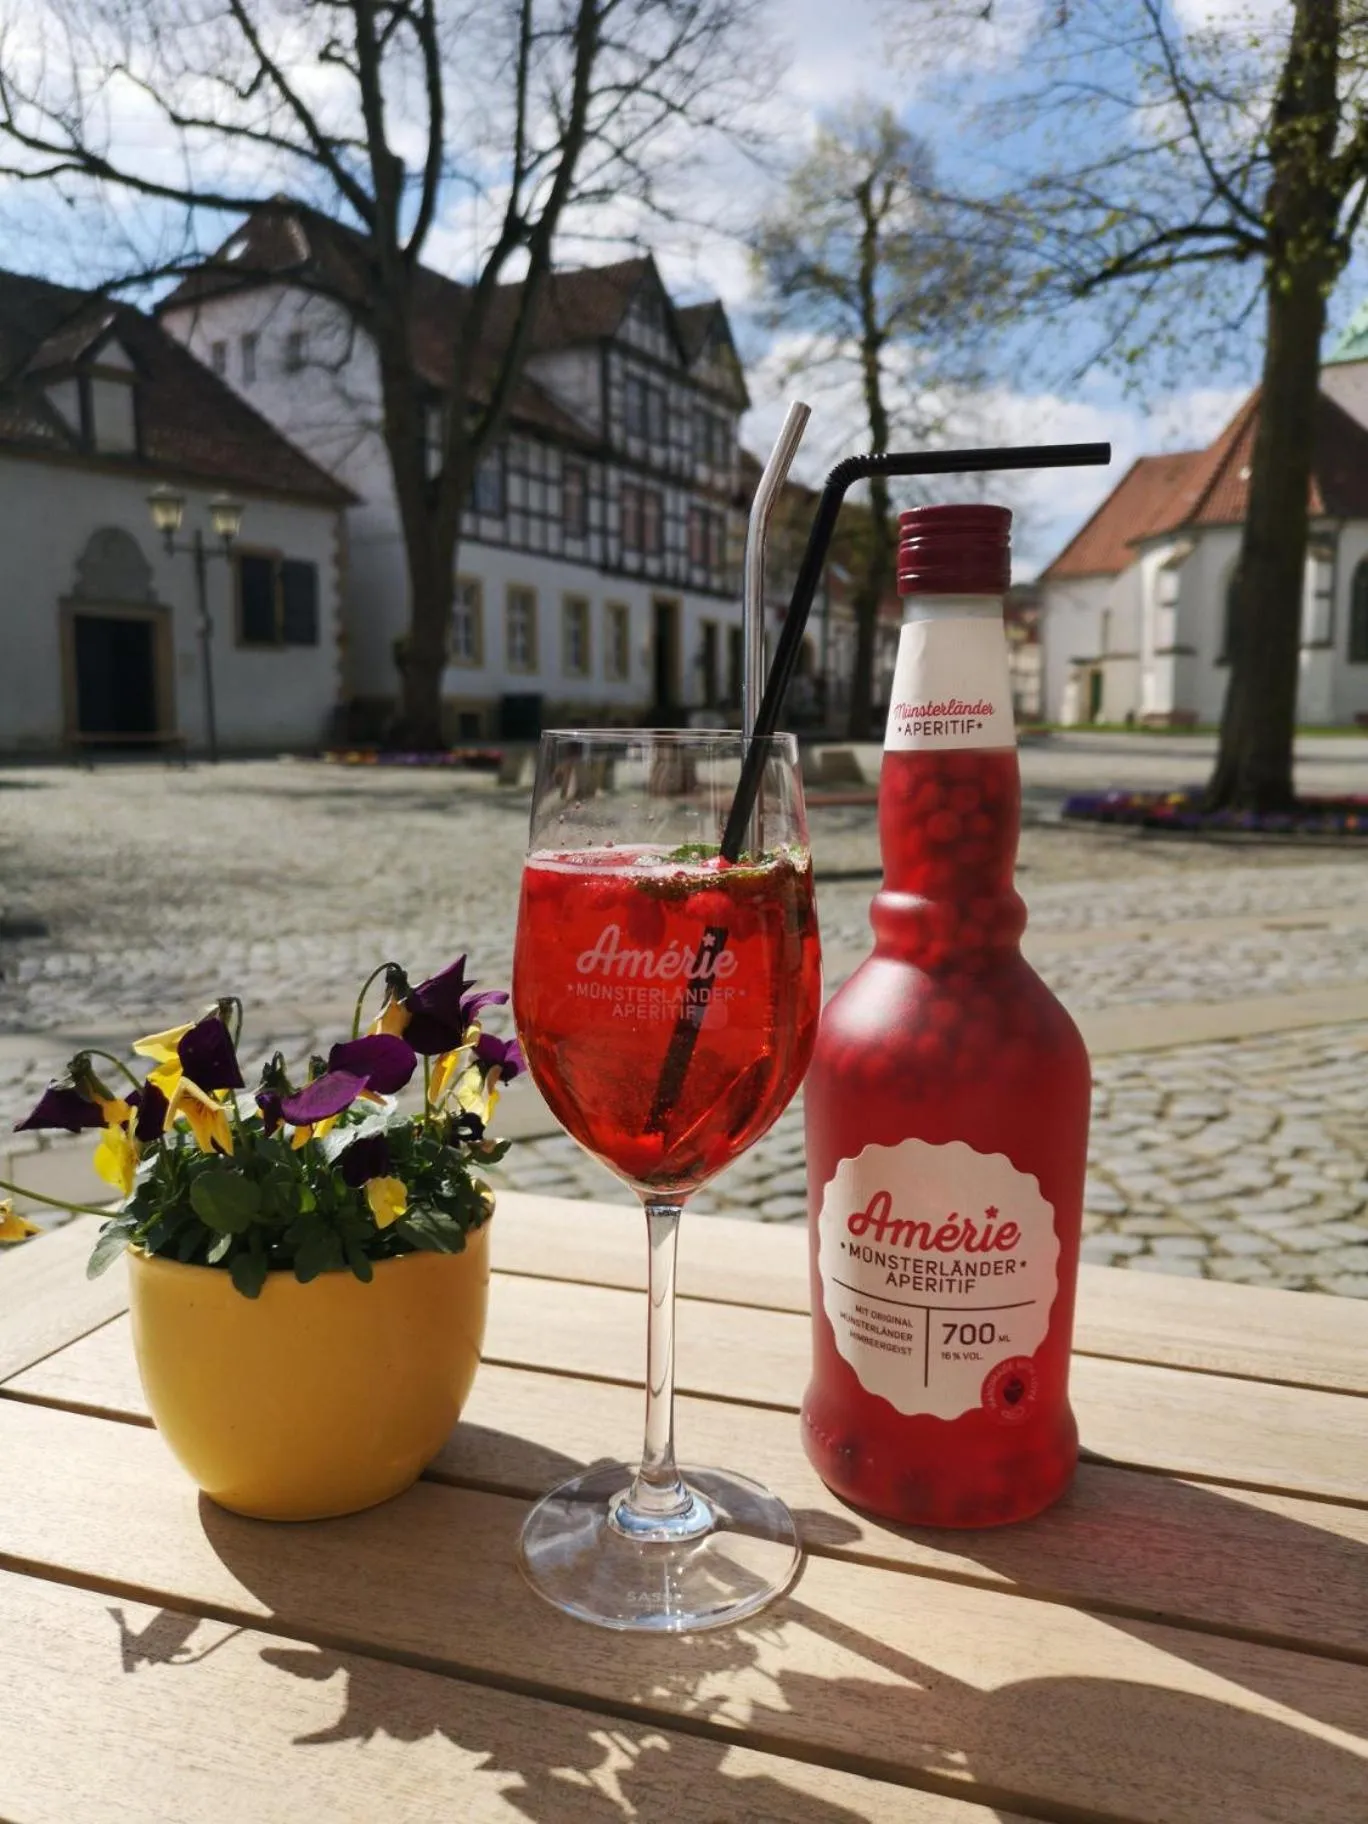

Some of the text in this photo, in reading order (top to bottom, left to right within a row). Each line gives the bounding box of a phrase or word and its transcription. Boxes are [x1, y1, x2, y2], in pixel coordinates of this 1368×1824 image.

[905, 720, 975, 736] APERITIF
[576, 924, 738, 979] Amérie
[576, 982, 735, 1004] MÜNSTERLÄNDER
[612, 1003, 696, 1019] APERITIF
[847, 1190, 1021, 1252] Amérie
[849, 1242, 1016, 1277] MÜNSTERLÄNDER
[885, 1272, 976, 1294] APERITIF
[855, 1304, 913, 1328] MIT ORIGINAL
[942, 1323, 995, 1345] 700
